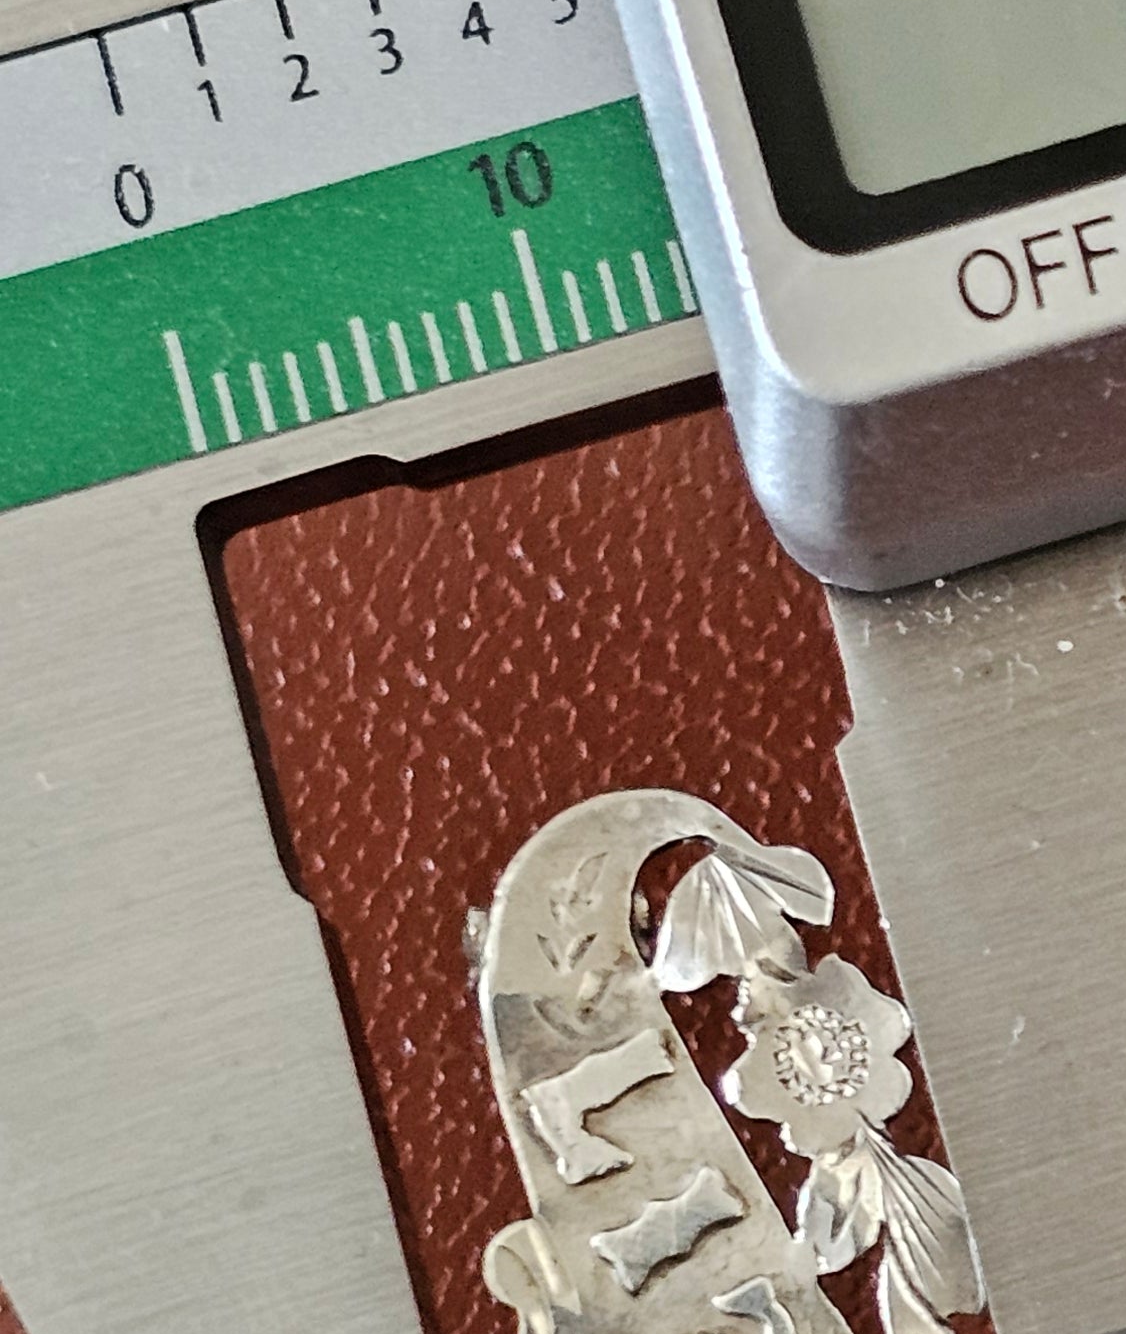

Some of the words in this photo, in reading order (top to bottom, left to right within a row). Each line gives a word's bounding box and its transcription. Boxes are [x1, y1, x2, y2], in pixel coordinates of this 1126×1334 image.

[114, 163, 155, 229] 0
[196, 78, 223, 123] 1
[282, 53, 320, 101] 2
[369, 27, 404, 75] 3
[460, 0, 494, 46] 4
[468, 139, 554, 218] 10
[955, 214, 1121, 323] OFF
